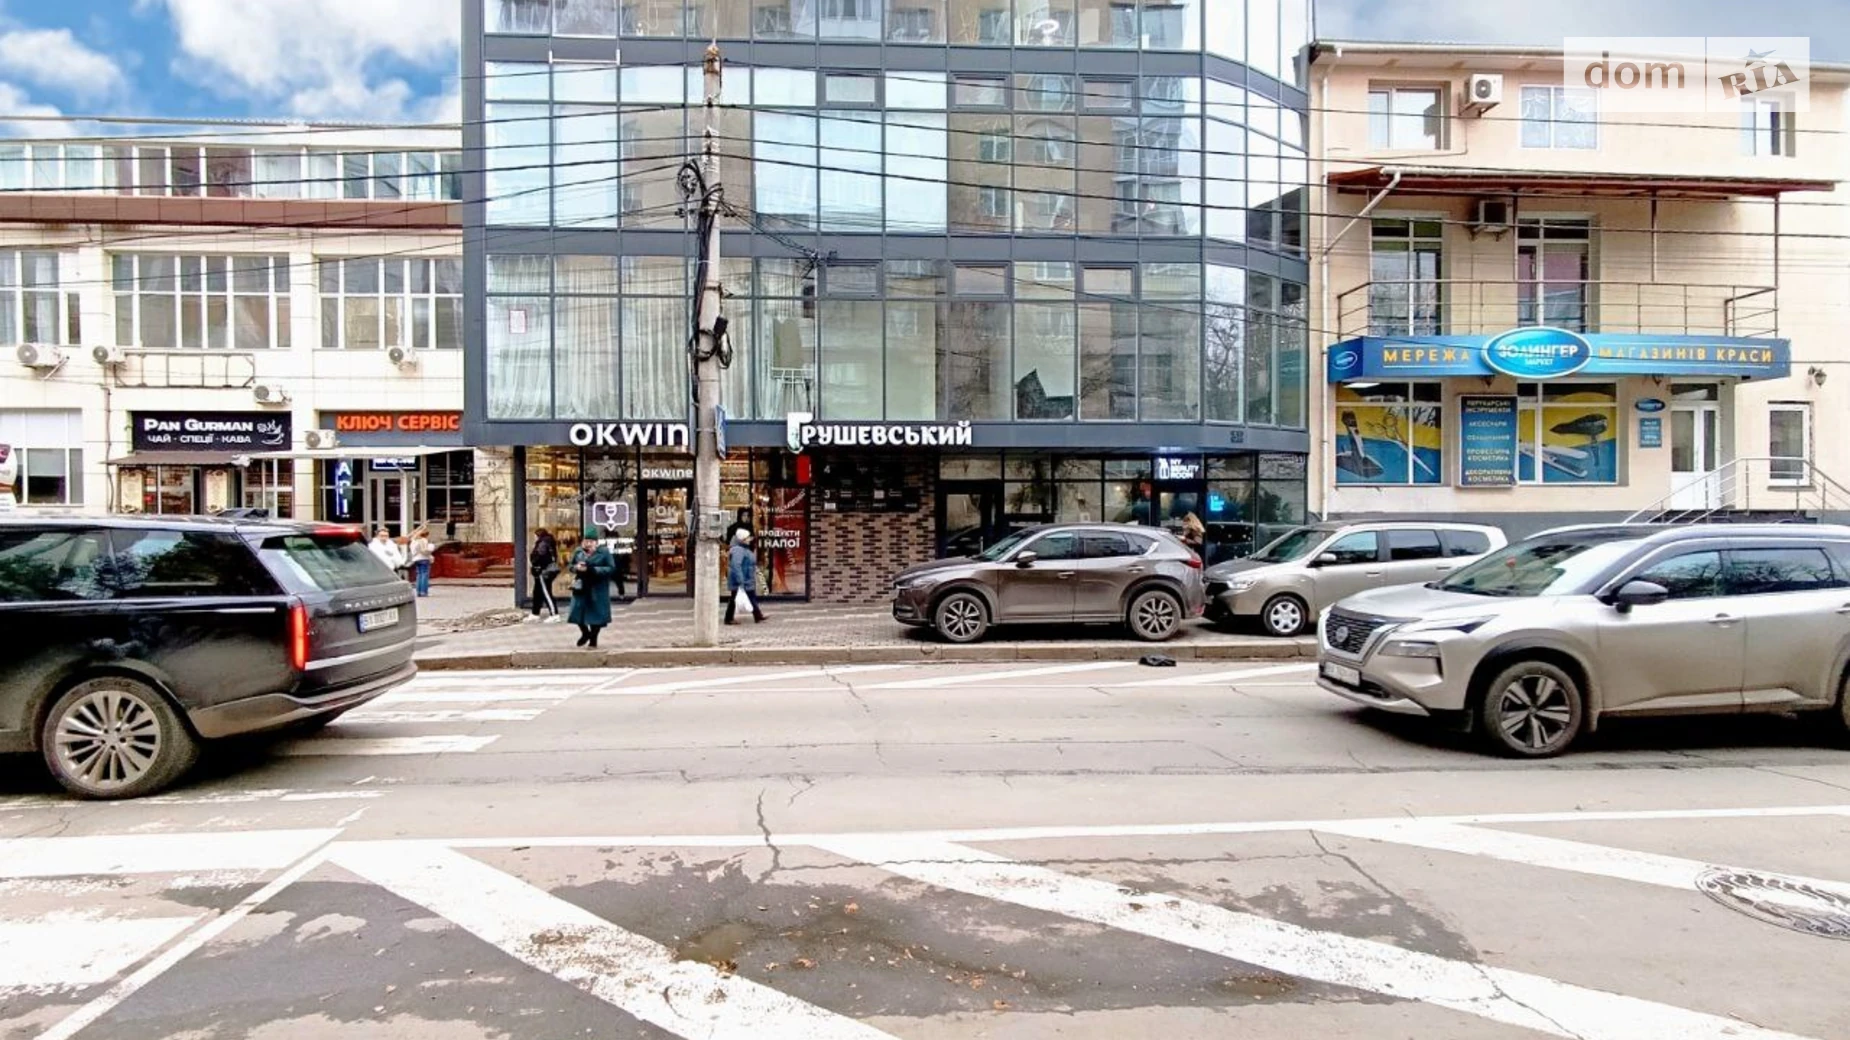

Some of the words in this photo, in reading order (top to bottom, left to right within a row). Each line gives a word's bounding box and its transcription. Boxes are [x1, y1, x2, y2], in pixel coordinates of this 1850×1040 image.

[1383, 348, 1469, 362] МЕРЕЖА
[1498, 344, 1579, 358] ЗОЛИНГЕР
[1599, 347, 1706, 361] МАГАЗИНІВ
[1716, 348, 1772, 362] КРАСИ
[144, 418, 181, 431] PAN
[184, 418, 253, 431] GURMAN
[336, 414, 393, 430] КЛЮЧ
[397, 414, 460, 430] СЕРВІС
[148, 434, 171, 443] ЧАЙ
[180, 433, 214, 444] СПЕЦІЇ
[222, 434, 251, 443] КАВА
[823, 489, 831, 499] 3
[758, 530, 800, 538] ПРОДУКТИ
[764, 537, 800, 548] НАПОЇ
